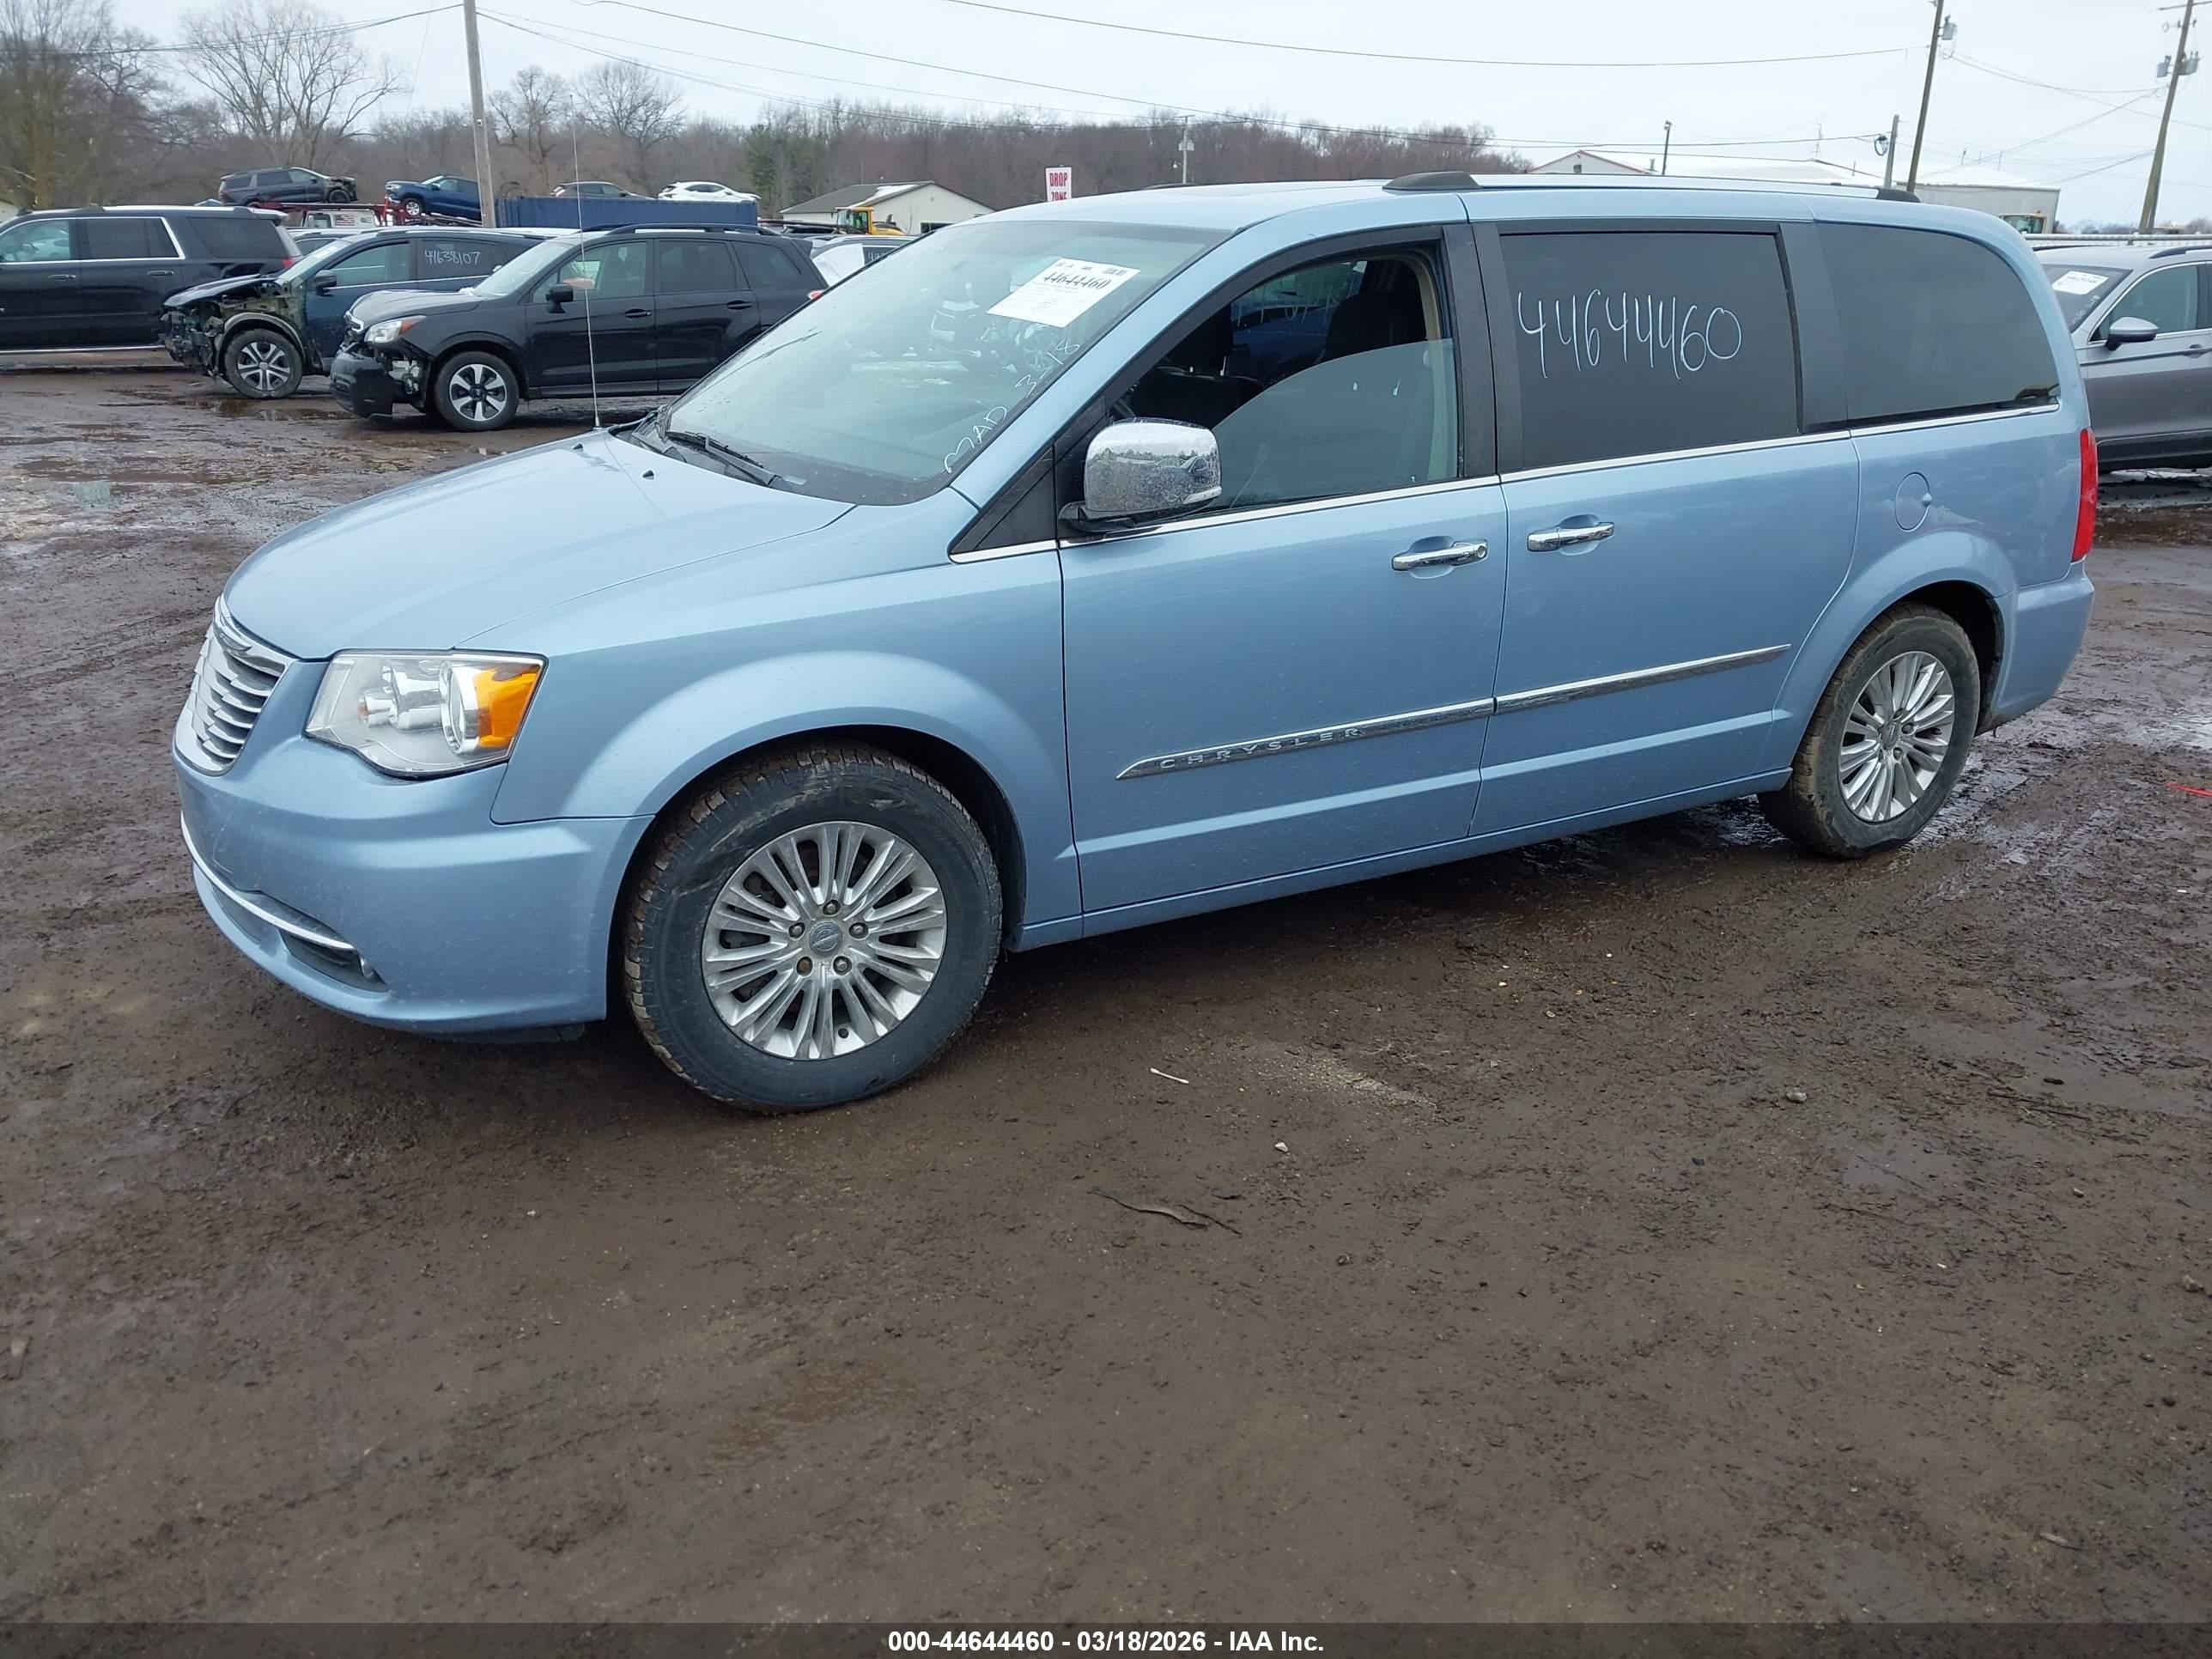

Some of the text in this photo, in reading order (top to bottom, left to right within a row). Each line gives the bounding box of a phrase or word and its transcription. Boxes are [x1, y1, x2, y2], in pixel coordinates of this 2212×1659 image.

[1049, 172, 1067, 186] DROP
[1042, 271, 1112, 289] 44644460
[1517, 289, 1742, 380] 44644460
[1014, 338, 1080, 398] 3-18
[1159, 727, 1360, 769] CHRYSLER
